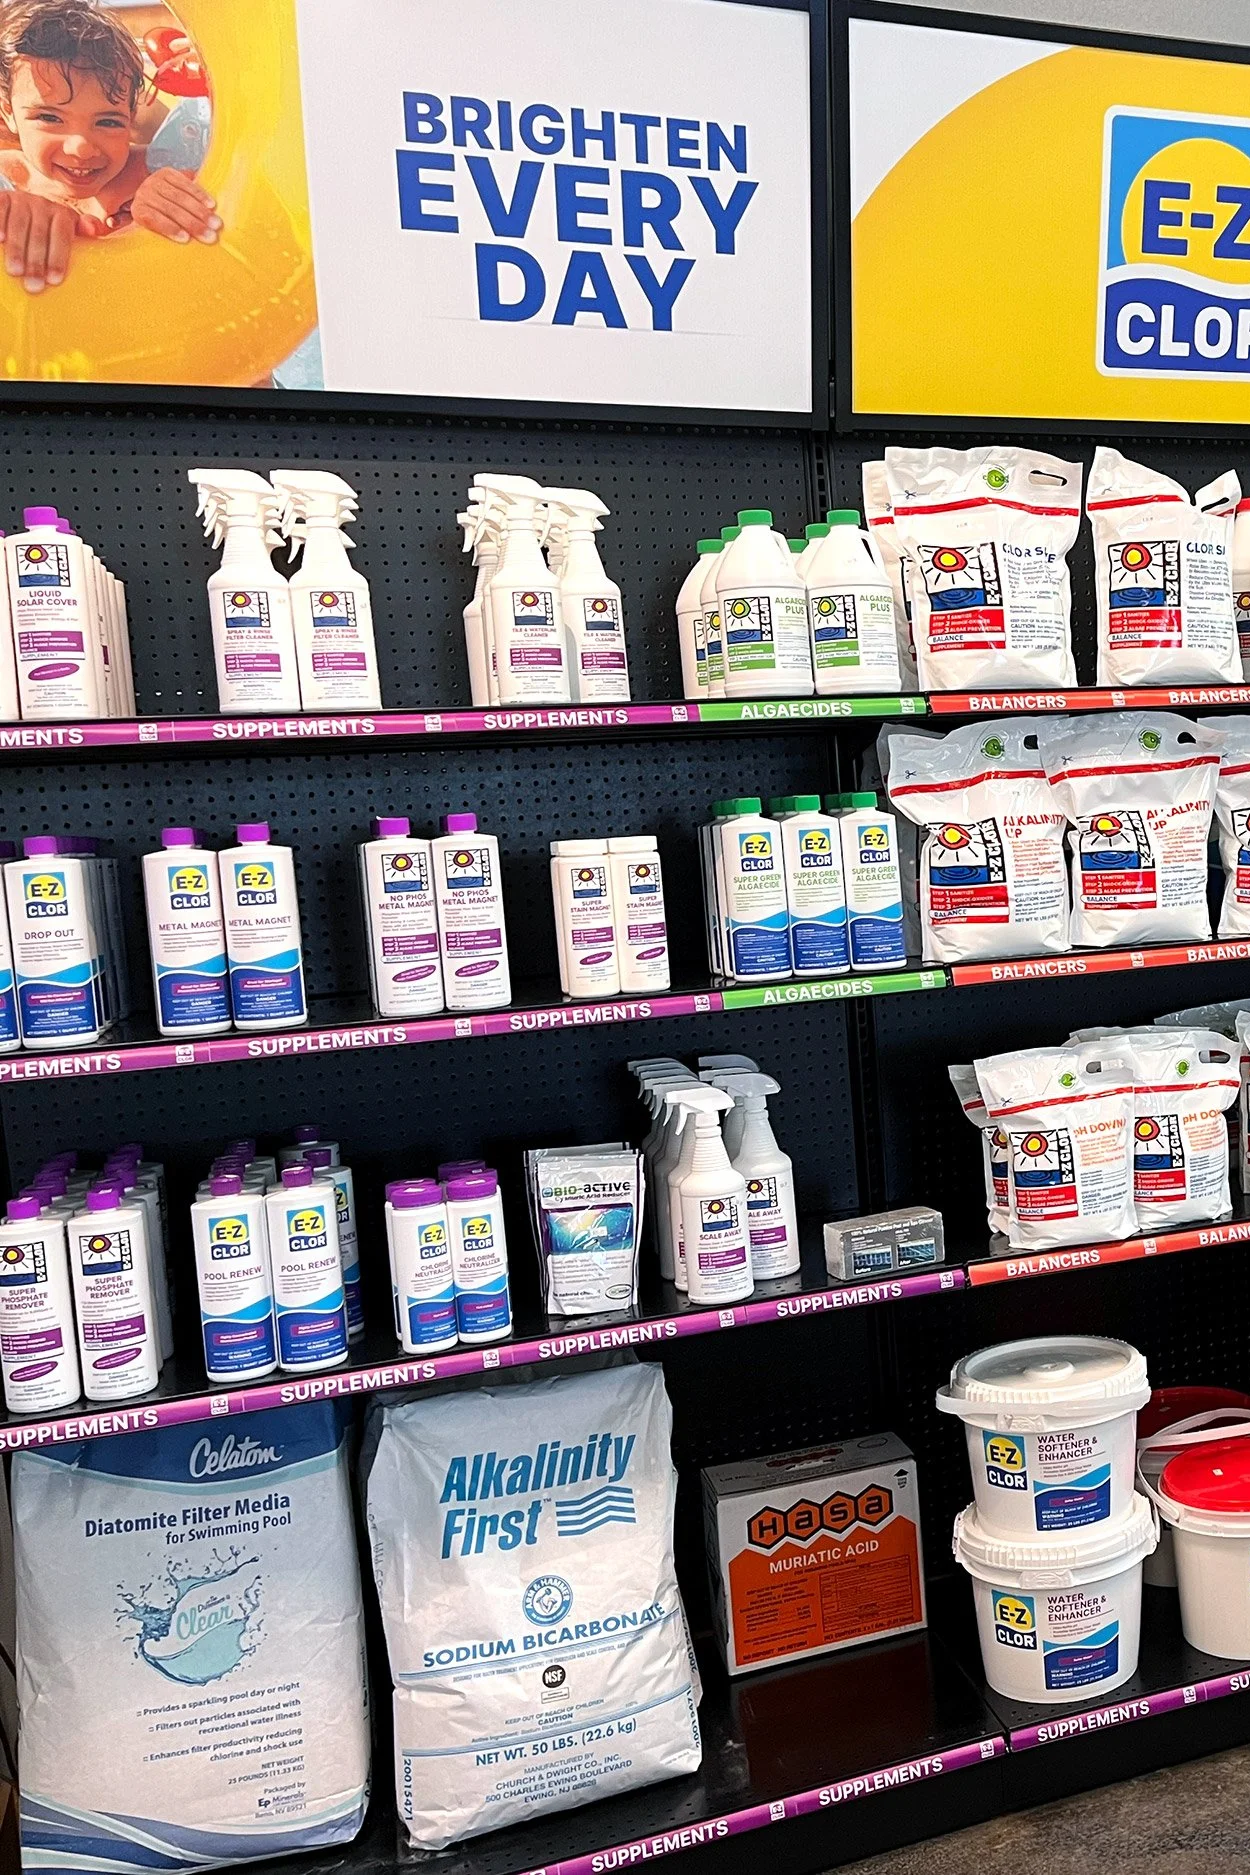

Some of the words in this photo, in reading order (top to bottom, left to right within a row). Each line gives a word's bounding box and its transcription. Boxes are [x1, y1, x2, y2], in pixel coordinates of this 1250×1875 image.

[403, 92, 748, 174] BRIGHTEN
[395, 150, 760, 255] EVERY
[475, 243, 697, 332] DAY
[29, 590, 61, 598] LIQUID
[17, 600, 46, 608] SOLAR
[48, 599, 78, 607] COVER
[870, 603, 891, 613] PLUS
[741, 702, 853, 719] ALGAECIDES
[969, 695, 1067, 711] BALANCERS
[212, 718, 376, 738] SUPPLEMENTS
[484, 710, 628, 730] SUPPLEMENTS
[745, 841, 767, 854] E-Z
[742, 859, 773, 871] CLOR
[241, 872, 268, 886] E-Z
[733, 874, 758, 884] SUPER
[759, 873, 781, 882] GREEN
[737, 882, 780, 891] ALGAECIDE
[31, 883, 59, 897] E-Z
[239, 892, 276, 905] CLOR
[452, 890, 464, 898] NO
[467, 889, 489, 897] PHOS
[442, 897, 468, 906] METAL
[471, 895, 498, 904] MAGNET
[28, 904, 66, 918] CLOR
[229, 917, 255, 927] METAL
[256, 915, 292, 926] MAGNET
[24, 929, 52, 940] DROP
[55, 929, 74, 938] OUT
[991, 960, 1087, 979] BALANCERS
[763, 980, 874, 1004] ALGAECIDES
[510, 1002, 652, 1031] SUPPLEMENTS
[248, 1026, 408, 1056] SUPPLEMENTS
[216, 1225, 243, 1241] E-Z
[700, 1232, 722, 1240] SCALE
[723, 1228, 742, 1238] AWAY
[213, 1245, 250, 1259] CLOR
[464, 1253, 495, 1263] CHLORINE
[459, 1257, 501, 1269] NEUTRALIZER
[1007, 1250, 1101, 1277] BALANCERS
[94, 1275, 123, 1285] SUPER
[204, 1270, 227, 1281] POOL
[229, 1266, 262, 1278] RENEW
[85, 1279, 133, 1292] PHOSPHATE
[90, 1288, 130, 1299] REMOVER
[776, 1283, 903, 1317] SUPPLEMENTS
[538, 1321, 678, 1359] SUPPLEMENTS
[280, 1362, 436, 1403] SUPPLEMENTS
[0, 1409, 158, 1450] SUPPLEMENTS
[1037, 1433, 1075, 1444] WATER
[1038, 1439, 1090, 1454] SOFTENER
[1091, 1436, 1098, 1446] &
[189, 1435, 282, 1479] Celatom
[990, 1444, 1018, 1466] E-Z
[1038, 1446, 1093, 1463] ENHANCER
[439, 1432, 636, 1504] Alkalinity
[988, 1469, 1026, 1489] CLOR
[85, 1512, 177, 1538] Diatomite
[182, 1503, 231, 1526] Filter
[234, 1494, 291, 1517] Media
[166, 1531, 186, 1545] for
[188, 1519, 260, 1543] Swimming
[263, 1511, 292, 1528] Pool
[441, 1500, 543, 1560] First
[769, 1546, 842, 1575] MURIATIC
[845, 1539, 880, 1558] ACID
[176, 1602, 235, 1641] Clear
[423, 1637, 516, 1669] SODIUM
[523, 1601, 666, 1651] BICARBONATE
[544, 1669, 564, 1684] NSF
[143, 1703, 181, 1717] Provides
[181, 1702, 187, 1710] a
[188, 1695, 228, 1710] sparkling
[230, 1690, 249, 1703] pool
[250, 1687, 266, 1699] day
[267, 1687, 276, 1695] or
[277, 1681, 301, 1695] night
[538, 1713, 573, 1726] CAUTION
[1037, 1700, 1150, 1743] SUPPLEMENTS
[475, 1751, 502, 1766] NET
[505, 1747, 528, 1761] WT.
[532, 1743, 549, 1756] 50
[552, 1735, 578, 1751] LBS.
[582, 1727, 614, 1747] (22.6
[617, 1717, 637, 1736] kg)
[496, 1774, 536, 1791] CHURCH
[538, 1772, 545, 1781] &
[546, 1764, 582, 1780] DWIGHT
[604, 1754, 622, 1765] INC.
[818, 1756, 944, 1807] SUPPLEMENTS
[403, 1758, 414, 1821] 20015471
[591, 1820, 729, 1873] SUPPLEMENTS
